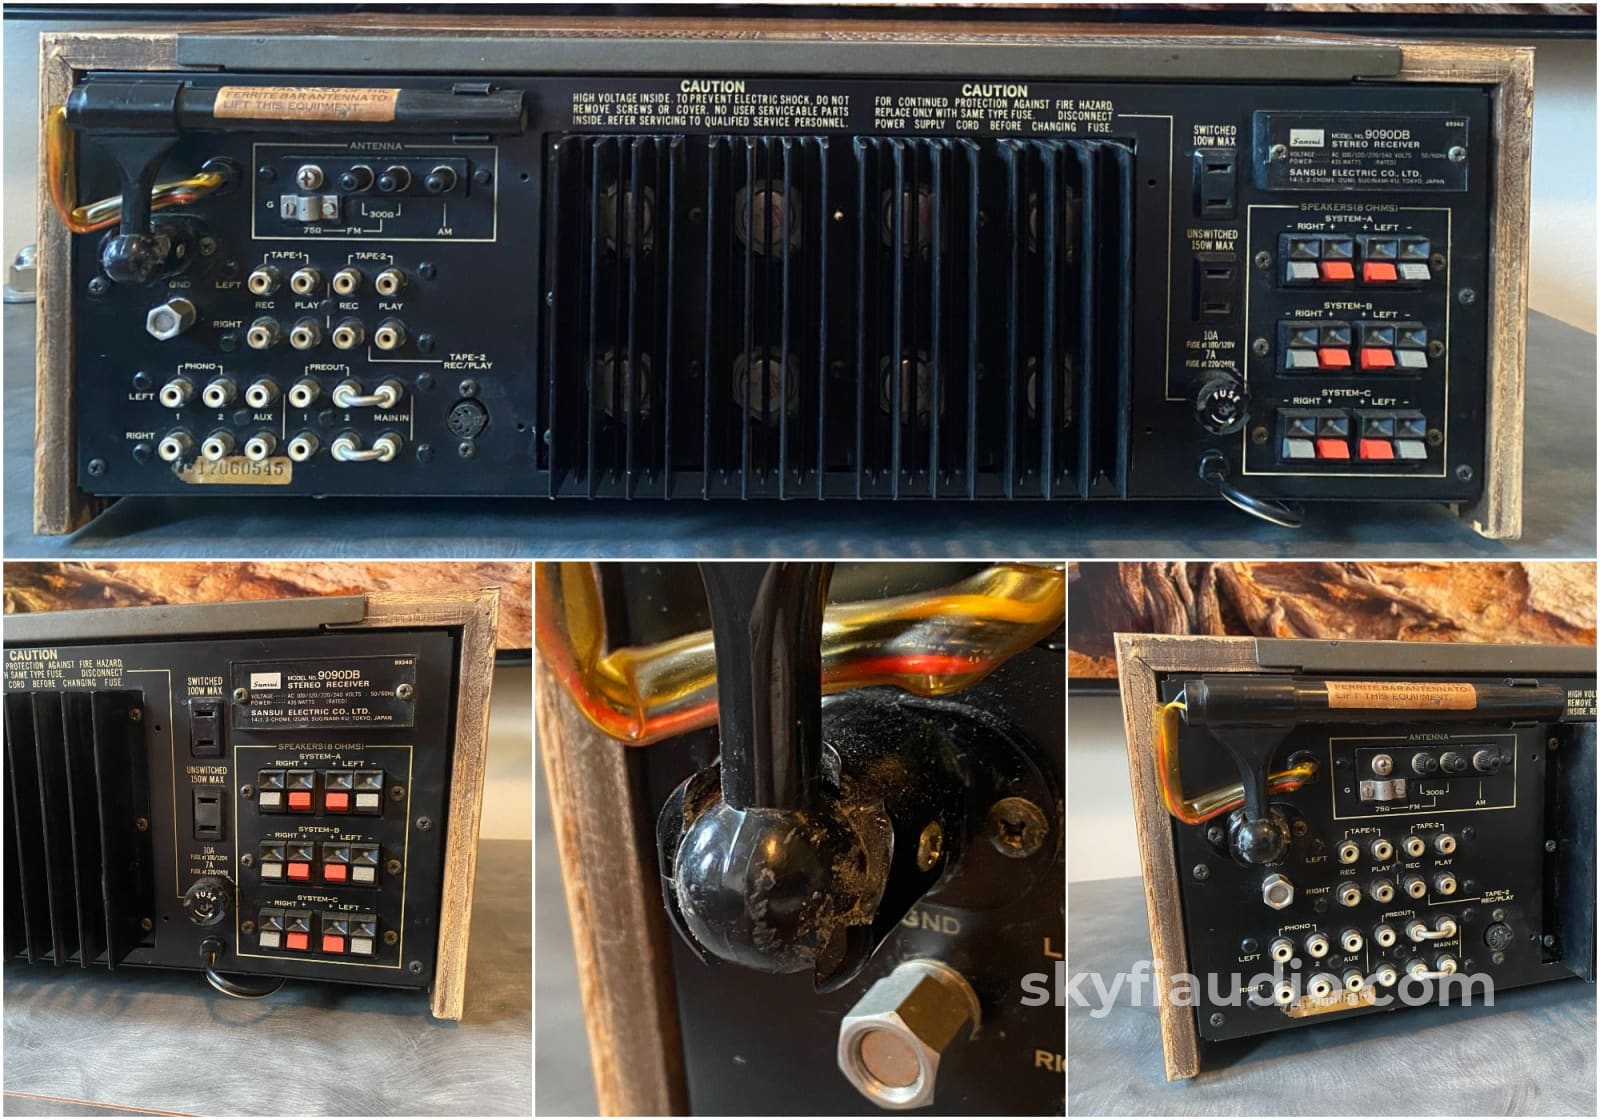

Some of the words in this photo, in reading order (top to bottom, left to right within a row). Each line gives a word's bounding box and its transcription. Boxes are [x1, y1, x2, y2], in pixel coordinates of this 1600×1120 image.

[681, 80, 745, 93] CAUTION
[962, 84, 1027, 97] CAUTION
[573, 93, 594, 103] HIGH
[598, 94, 637, 103] VOLTAGE
[640, 94, 673, 103] INSIDE.
[677, 94, 688, 104] TO
[690, 94, 732, 104] PREVENT
[735, 95, 778, 104] ELECTRIC
[780, 95, 813, 105] SHOCK,
[817, 96, 828, 105] DO
[831, 96, 849, 105] NOT
[875, 97, 891, 107] FOR
[899, 97, 948, 108] CONTINUED
[955, 98, 1007, 109] PROTECTION
[1014, 99, 1049, 110] AGAINST
[1056, 100, 1073, 110] FIRE
[1079, 101, 1114, 111] HAZARD.
[573, 104, 610, 114] REMOVE
[617, 105, 651, 114] SCREWS
[658, 105, 669, 114] OR
[677, 105, 709, 115] COVER.
[715, 106, 726, 115] NO
[734, 106, 755, 115] USER
[759, 106, 818, 116] SERVICEABLE
[822, 106, 848, 116] PARTS
[875, 108, 910, 118] REPLACE
[913, 109, 932, 118] ONLY
[936, 109, 957, 118] WITH
[961, 109, 984, 119] SAME
[988, 110, 1008, 119] TYPE
[1011, 110, 1035, 119] FUSE.
[1058, 111, 1112, 120] DISCONNECT
[573, 116, 605, 125] INSIDE.
[608, 116, 636, 126] REFER
[640, 116, 686, 126] SERVICING
[690, 117, 700, 126] TO
[705, 117, 749, 127] QUALIFIED
[753, 117, 790, 127] SERVICE
[795, 117, 848, 128] PERSONNEL.
[875, 119, 904, 129] POWER
[915, 120, 945, 130] SUPPLY
[956, 120, 979, 130] CORD
[990, 121, 1022, 131] BEFORE
[1032, 122, 1076, 132] CHANGING
[1088, 123, 1113, 132] FUSE.
[1194, 126, 1236, 135] SWITCHED
[1365, 130, 1410, 139] 9090DB
[350, 141, 402, 151] ANTENNA
[1193, 136, 1213, 146] 100W
[1217, 136, 1236, 146] MAX
[1187, 229, 1238, 239] UNSWITCHED
[1192, 240, 1212, 250] 150W
[1215, 241, 1234, 250] MAX
[271, 252, 303, 260] TAPE-1
[356, 252, 386, 260] TAPE-2
[216, 281, 241, 289] LEFT
[295, 302, 319, 310] PLAY
[339, 302, 358, 310] REC
[213, 320, 242, 328] RIGHT
[1204, 330, 1218, 340] 10A
[450, 354, 486, 362] TAPE-2
[1206, 350, 1216, 359] 7A
[310, 364, 344, 372] PREOUT
[444, 362, 492, 370] REC/PLAY
[129, 393, 154, 401] LEFT
[1214, 390, 1240, 402] FUSE
[253, 413, 273, 421] AUX
[126, 432, 154, 440] RIGHT
[10, 650, 58, 660] CAUTION
[6, 662, 43, 670] PROTECTION
[49, 661, 74, 669] AGAINST
[80, 660, 93, 668] FIRE
[96, 660, 123, 668] HAZARD.
[30, 670, 45, 678] TYPE
[47, 670, 64, 678] FUSE.
[81, 668, 123, 677] DISCONNECT
[318, 670, 360, 680] 9090DB
[8, 680, 24, 688] CORD
[32, 680, 56, 688] BEFORE
[63, 679, 96, 687] CHANGING
[105, 678, 124, 686] FUSE.
[188, 677, 223, 685] SWITCHED
[188, 687, 205, 695] 100W
[207, 687, 223, 695] MAX
[1568, 690, 1582, 698] HIGH
[1568, 699, 1592, 707] REMOVE
[187, 766, 227, 774] UNSWITCHED
[1481, 894, 1514, 904] REC/PLAY
[902, 911, 960, 935] GND
[1238, 954, 1260, 962] LEFT
